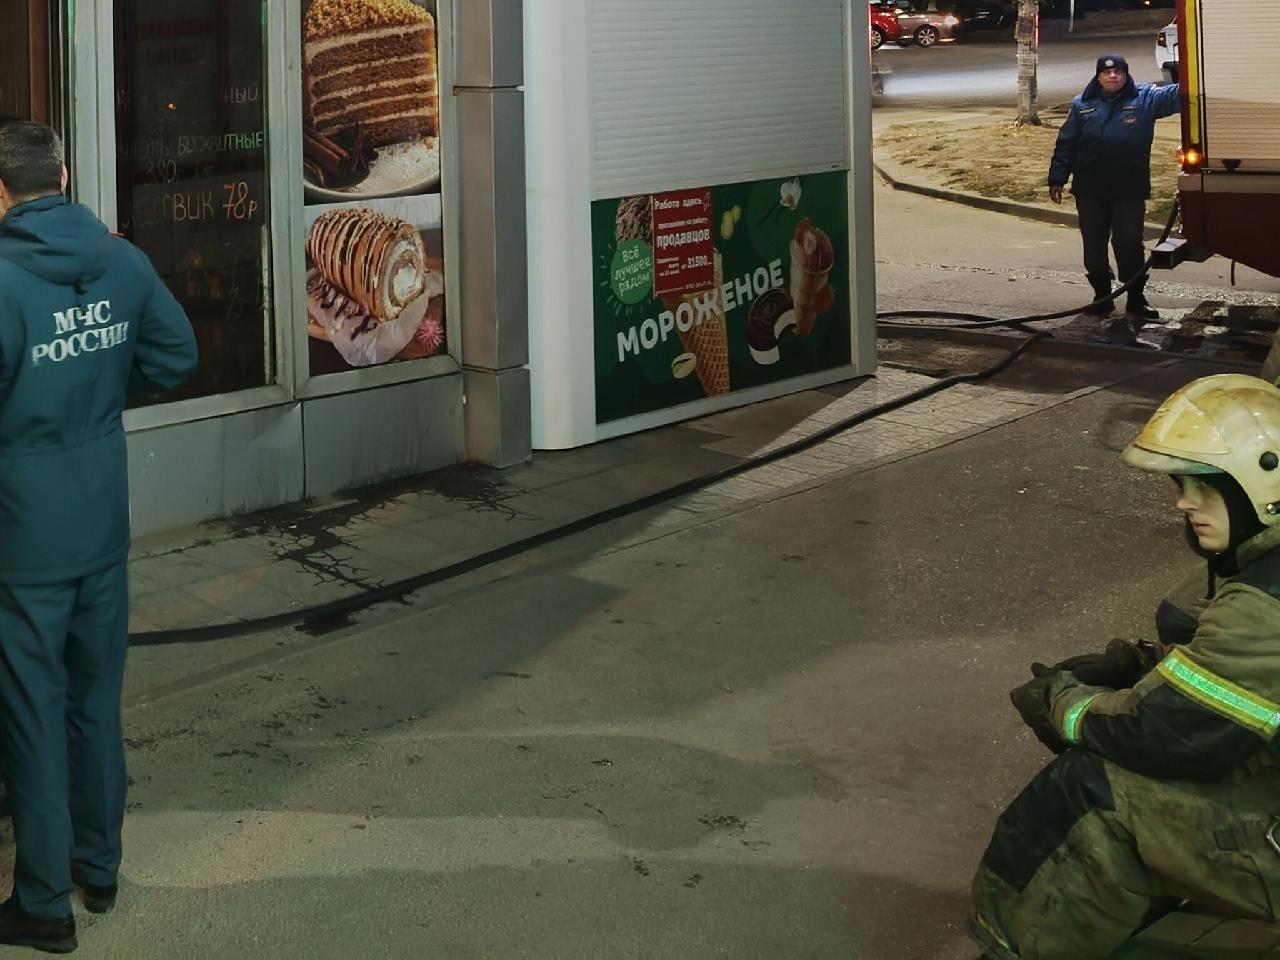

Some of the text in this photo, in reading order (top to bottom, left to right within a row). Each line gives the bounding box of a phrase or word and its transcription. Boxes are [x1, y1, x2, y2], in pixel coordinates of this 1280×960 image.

[656, 228, 710, 250] продавцов
[619, 272, 650, 297] рядом
[53, 300, 112, 335] МЧС
[616, 258, 784, 363] МОРОЖЕНОЕ
[32, 321, 130, 366] РОССИИ
